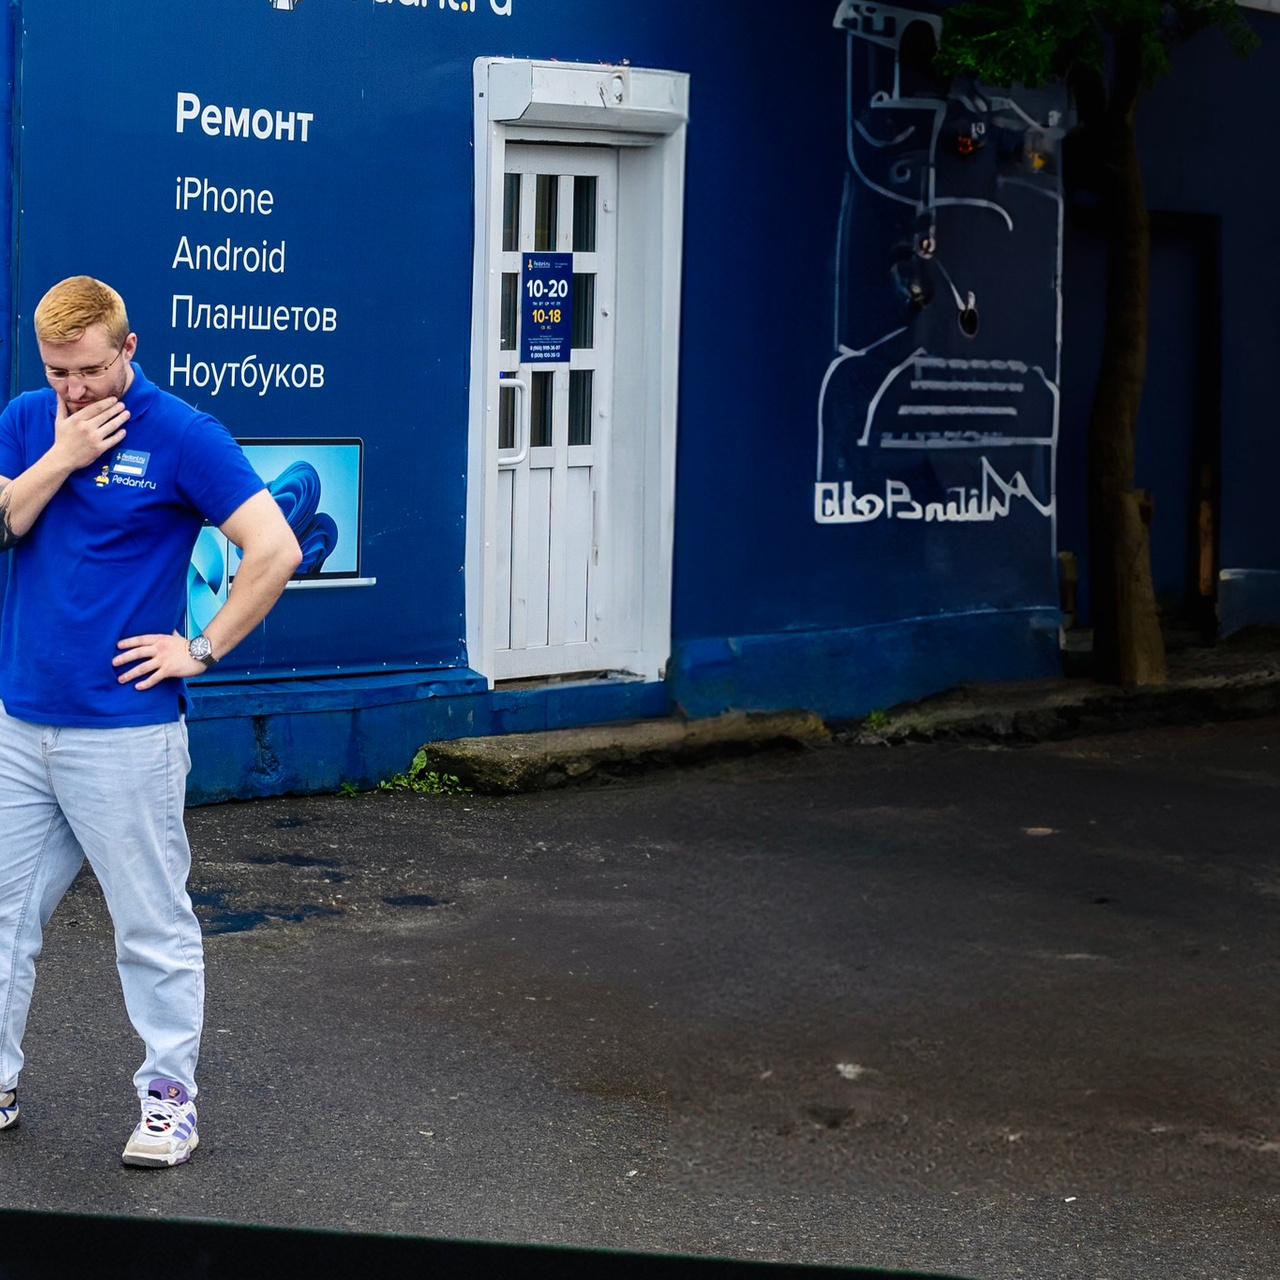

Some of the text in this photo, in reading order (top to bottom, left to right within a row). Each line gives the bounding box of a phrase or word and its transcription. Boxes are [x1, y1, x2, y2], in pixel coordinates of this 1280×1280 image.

[174, 91, 314, 143] Ремонт
[175, 177, 275, 215] iPhone
[171, 236, 287, 274] Android
[526, 279, 569, 298] 10-20
[170, 294, 338, 333] Планшетов
[532, 308, 562, 323] 10-18
[168, 353, 326, 397] Ноутбуков
